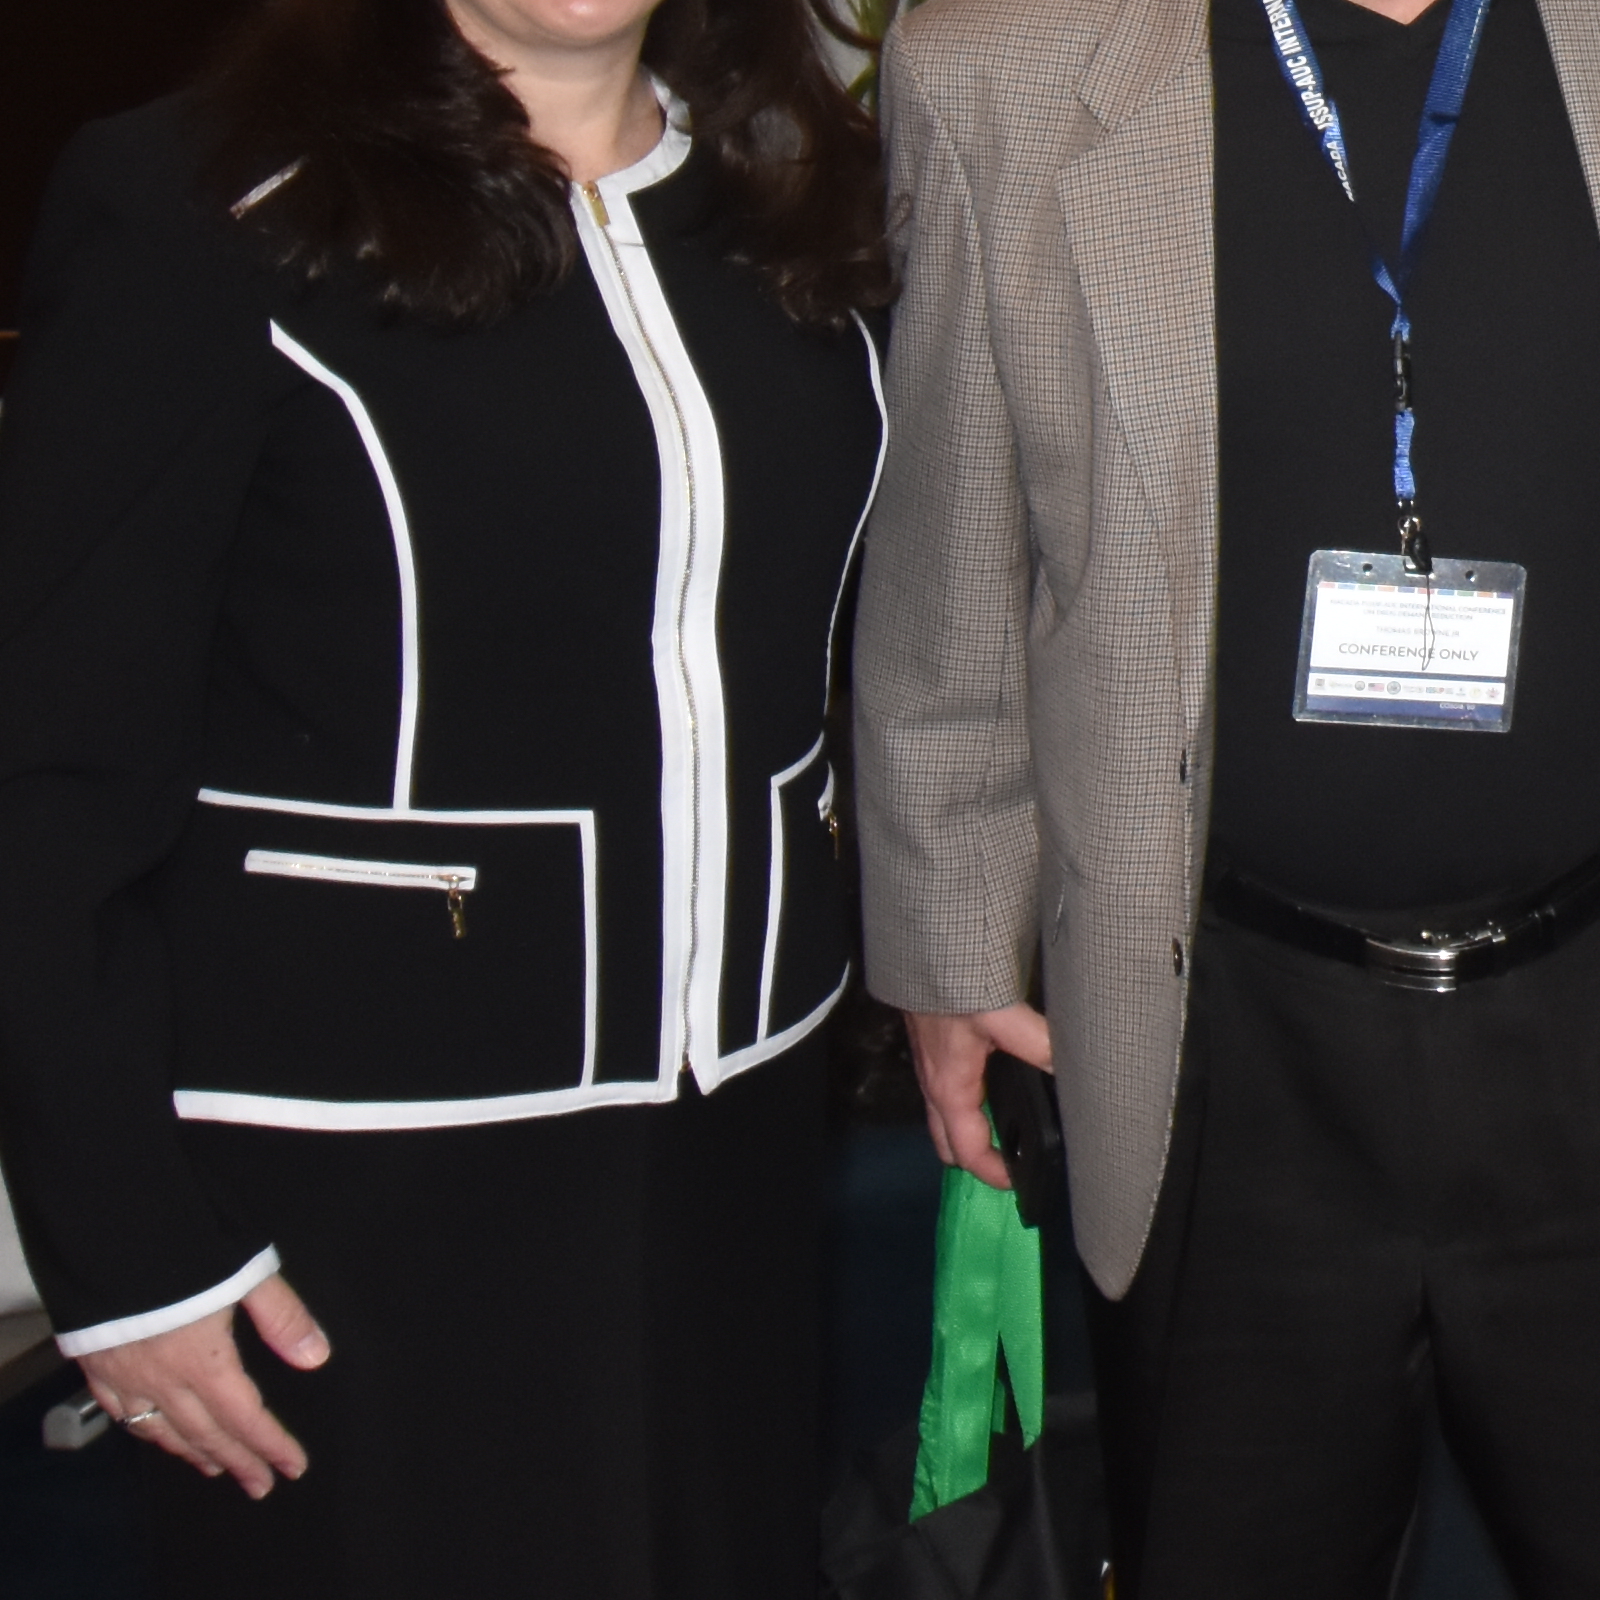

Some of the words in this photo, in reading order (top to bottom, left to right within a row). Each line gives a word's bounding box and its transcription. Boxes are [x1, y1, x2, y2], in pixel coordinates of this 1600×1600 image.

[1286, 56, 1334, 130] ISSUP-AUC
[1400, 602, 1456, 613] INTERNTIONAL
[1338, 643, 1435, 659] CONFERENCE
[1439, 649, 1479, 661] ONLY
